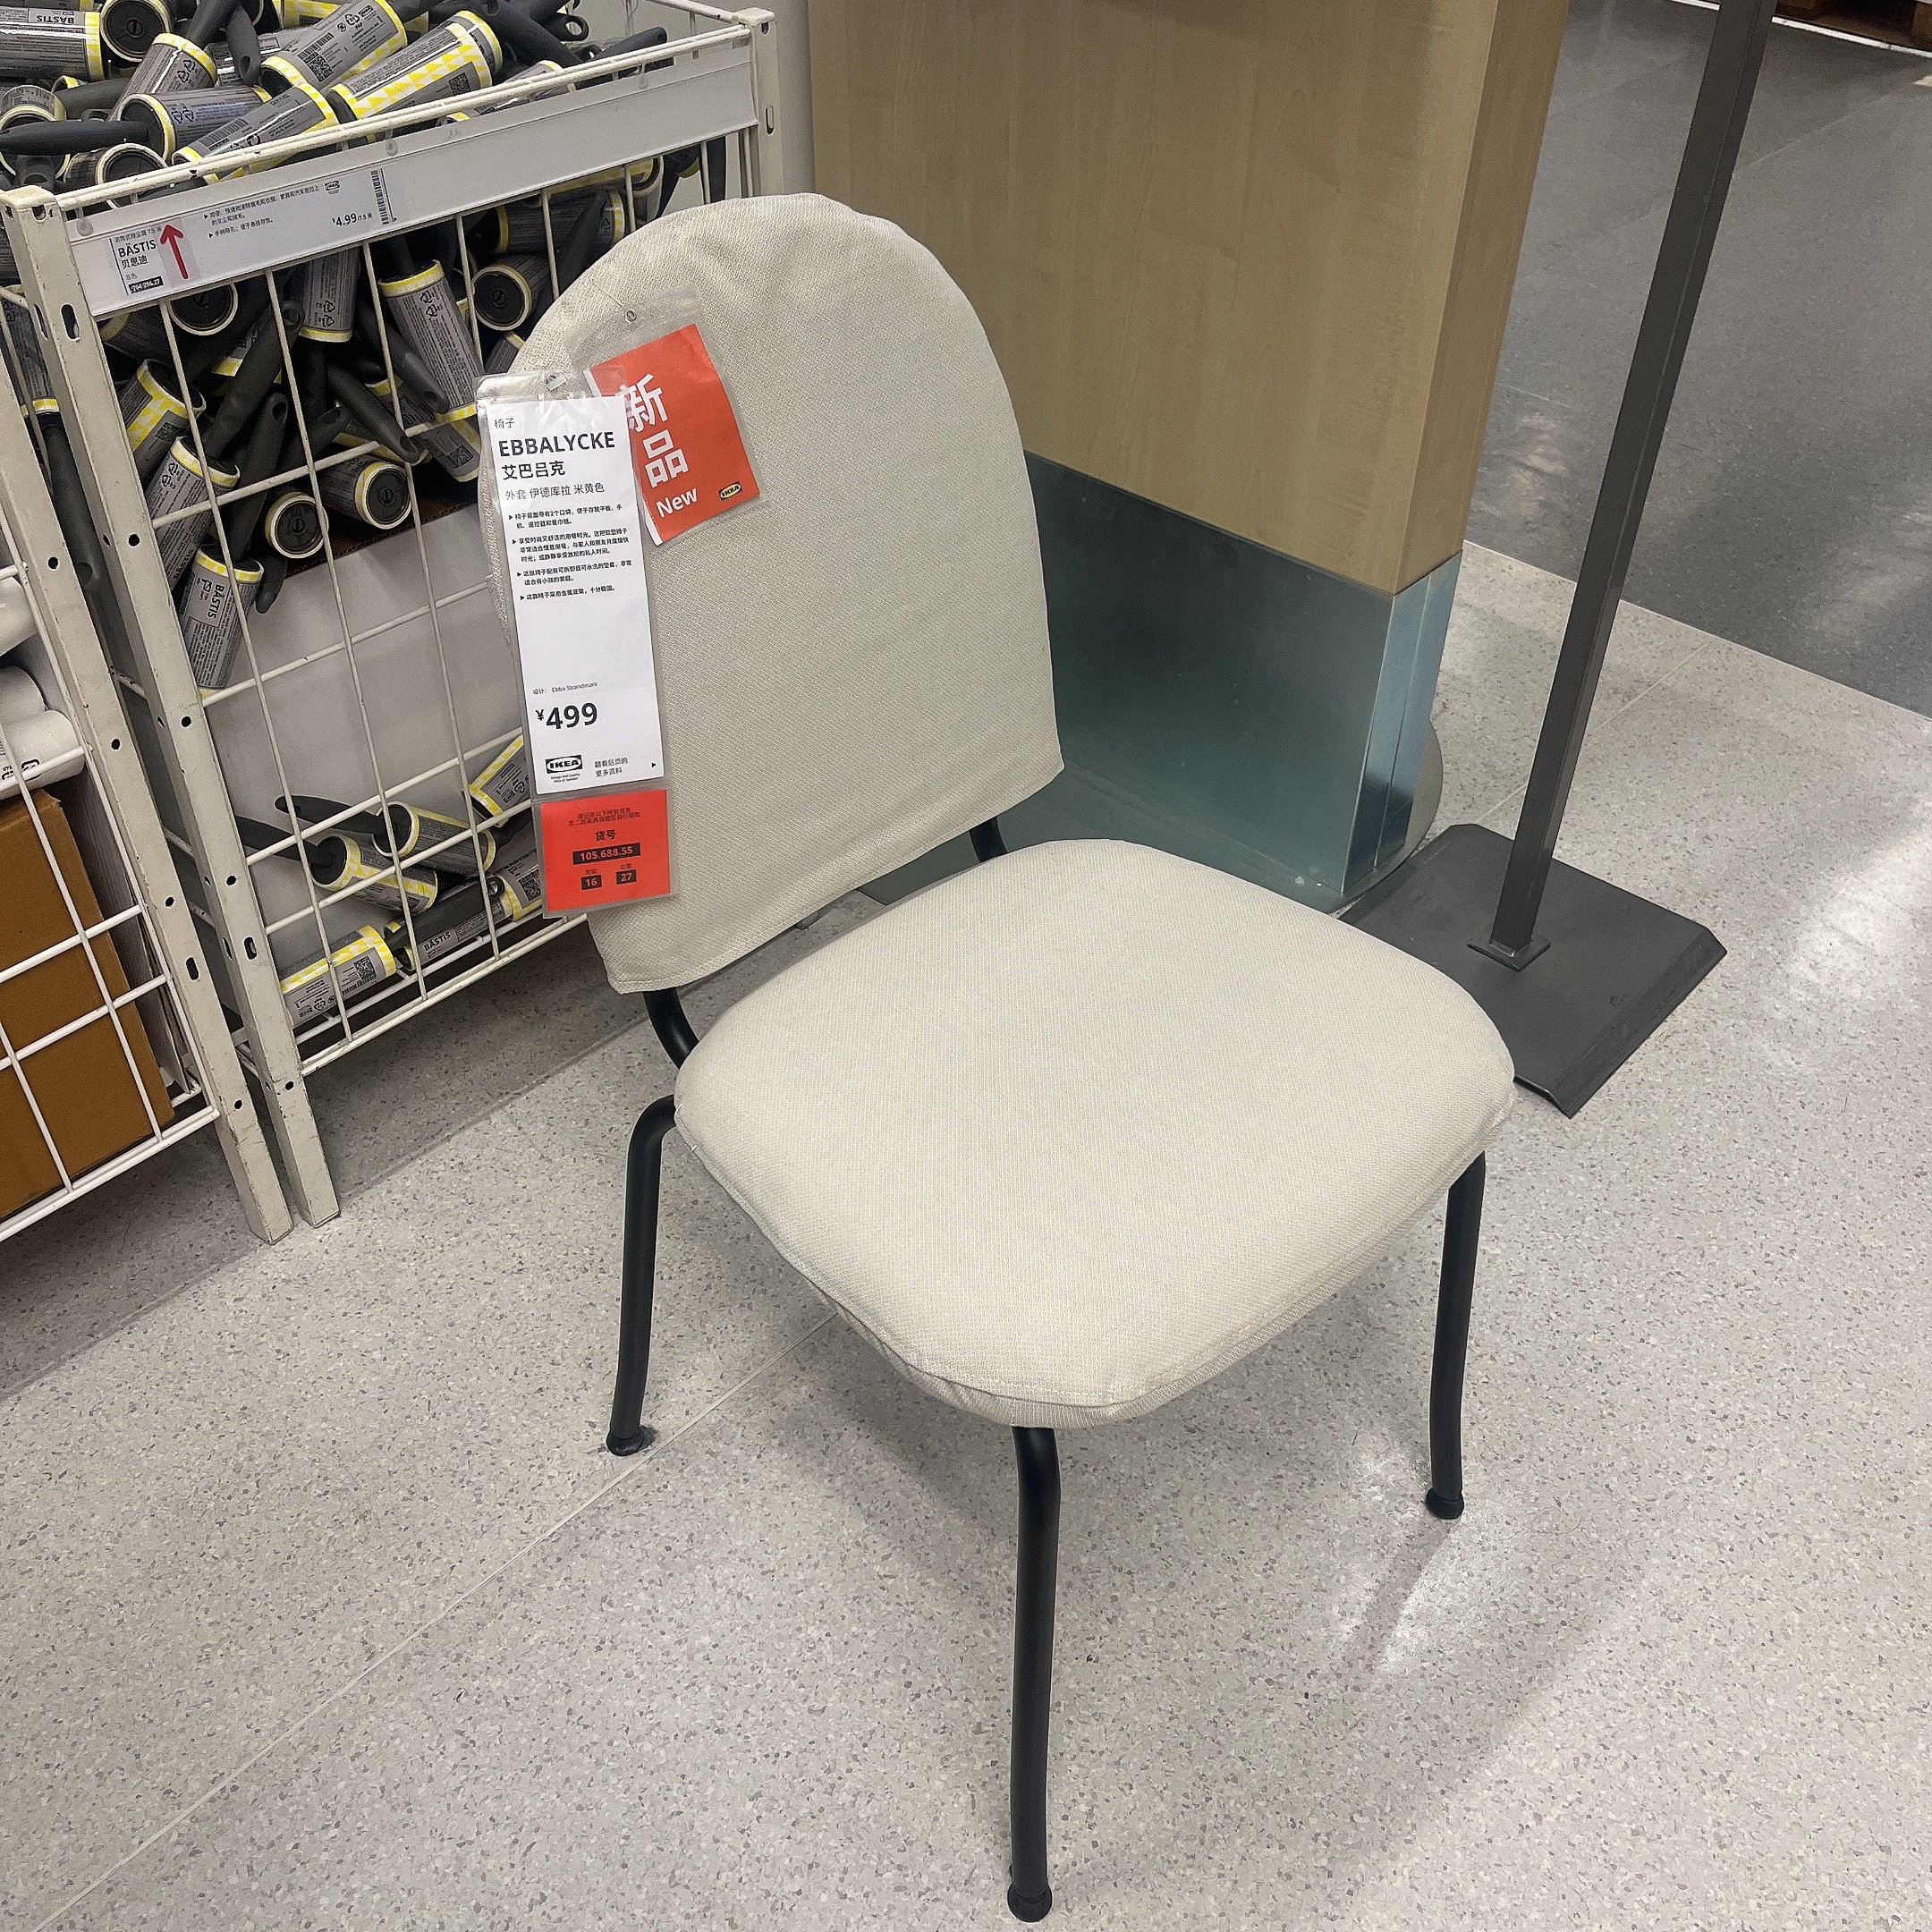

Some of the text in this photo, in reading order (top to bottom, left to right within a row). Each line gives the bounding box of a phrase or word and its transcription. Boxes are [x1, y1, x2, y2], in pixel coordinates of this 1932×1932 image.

[117, 239, 157, 258] BÄSTIS
[122, 254, 148, 269] 贝思迪
[495, 417, 515, 428] 椅子
[498, 431, 615, 456] EBBALYCKE
[502, 461, 565, 480] 艾巴吕克
[505, 482, 605, 501] 外套 伊德库拉 米黄色
[719, 483, 742, 500] IKEA
[656, 487, 698, 518] New
[208, 584, 225, 620] BÄSTIS
[551, 685, 565, 693] Ebba
[535, 702, 597, 730] ¥499
[547, 757, 581, 771] IKEA
[595, 829, 616, 842] 货号
[580, 845, 633, 861] 105.688.55
[585, 871, 633, 887] 16 27
[423, 931, 452, 953] BÄSTIS
